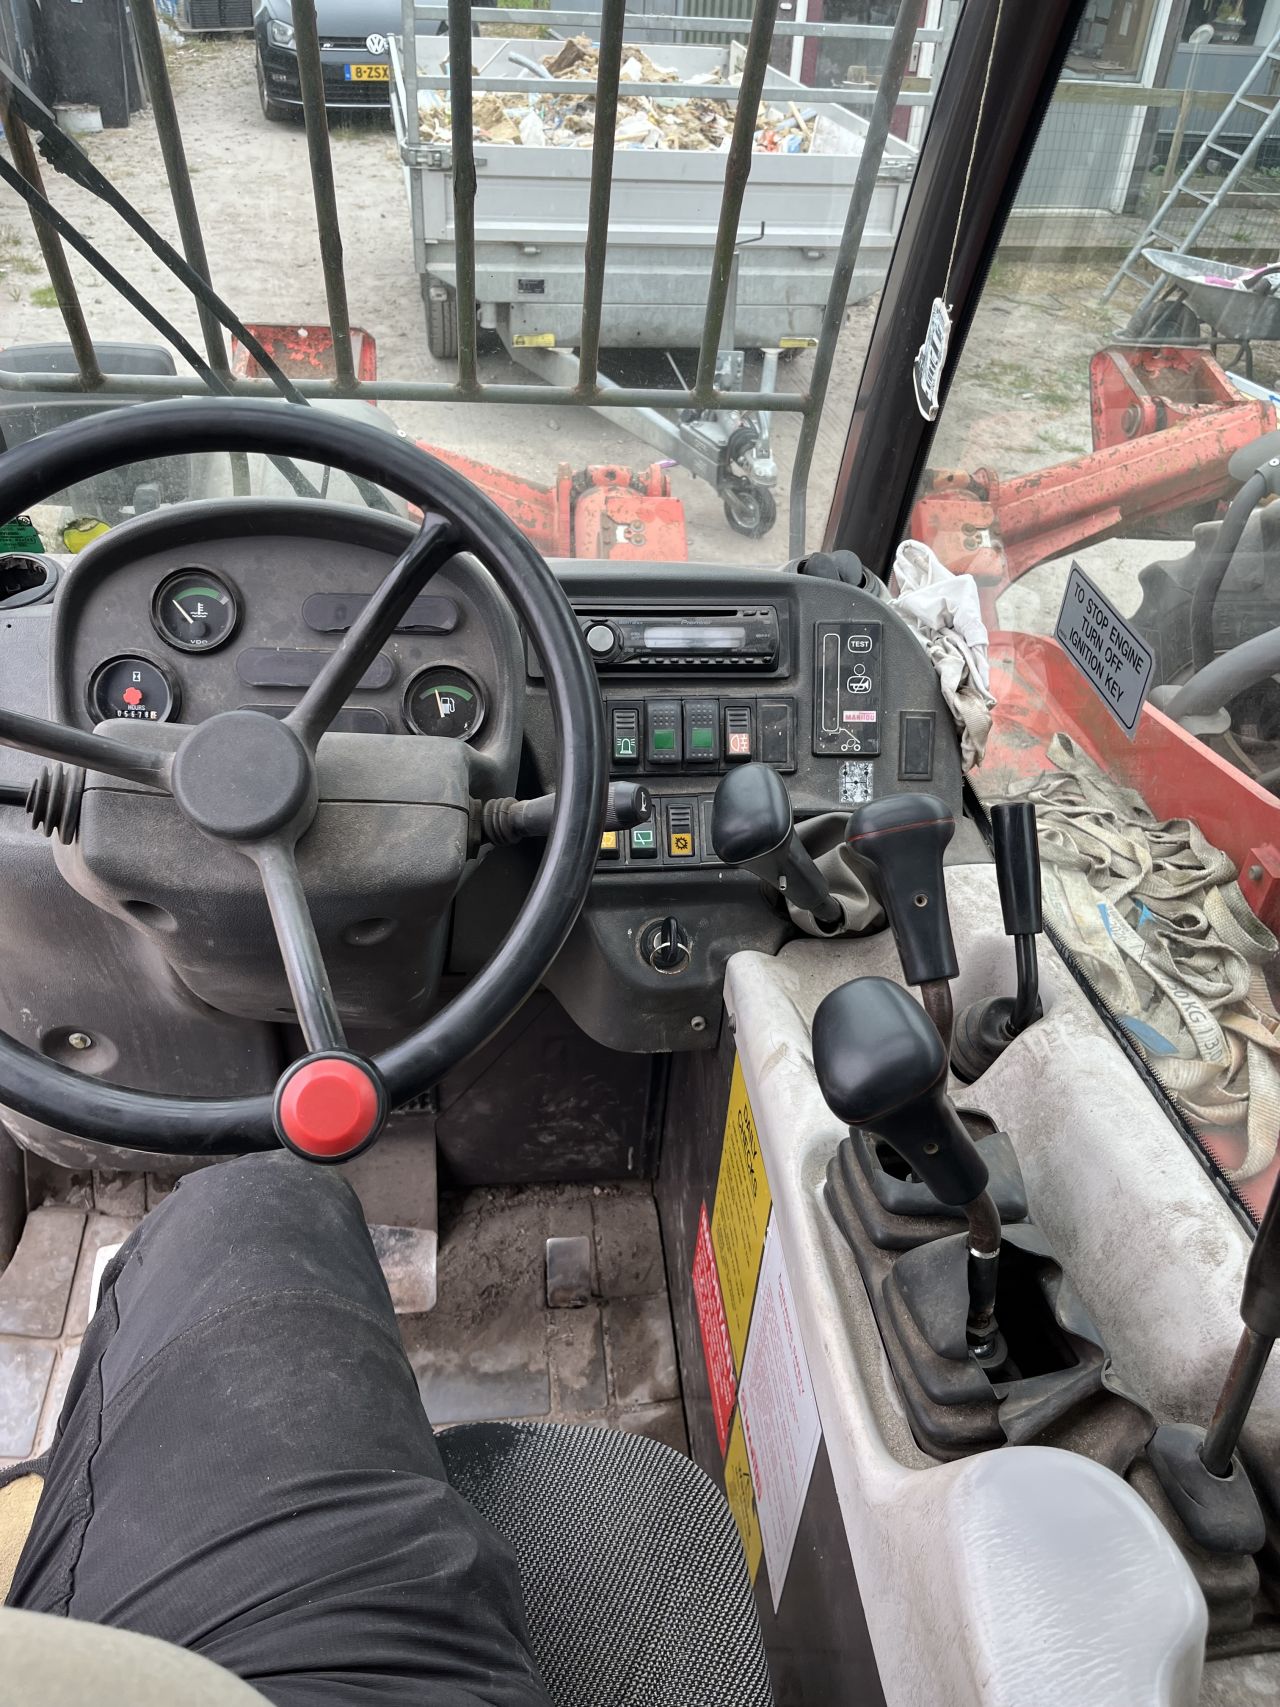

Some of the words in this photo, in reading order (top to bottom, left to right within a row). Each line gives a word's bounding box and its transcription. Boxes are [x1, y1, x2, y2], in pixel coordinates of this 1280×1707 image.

[1074, 581, 1085, 604] TO
[1086, 598, 1109, 630] STOP
[1109, 625, 1144, 675] ENGINE
[1082, 616, 1104, 653] TURN
[1104, 647, 1124, 674] OFF
[1069, 627, 1105, 679] IGNITION
[1104, 673, 1125, 703] KEY
[845, 713, 874, 721] MANITOU
[1181, 1001, 1207, 1023] KG
[738, 1110, 757, 1200] CHECKS
[743, 1103, 757, 1160] DAILY
